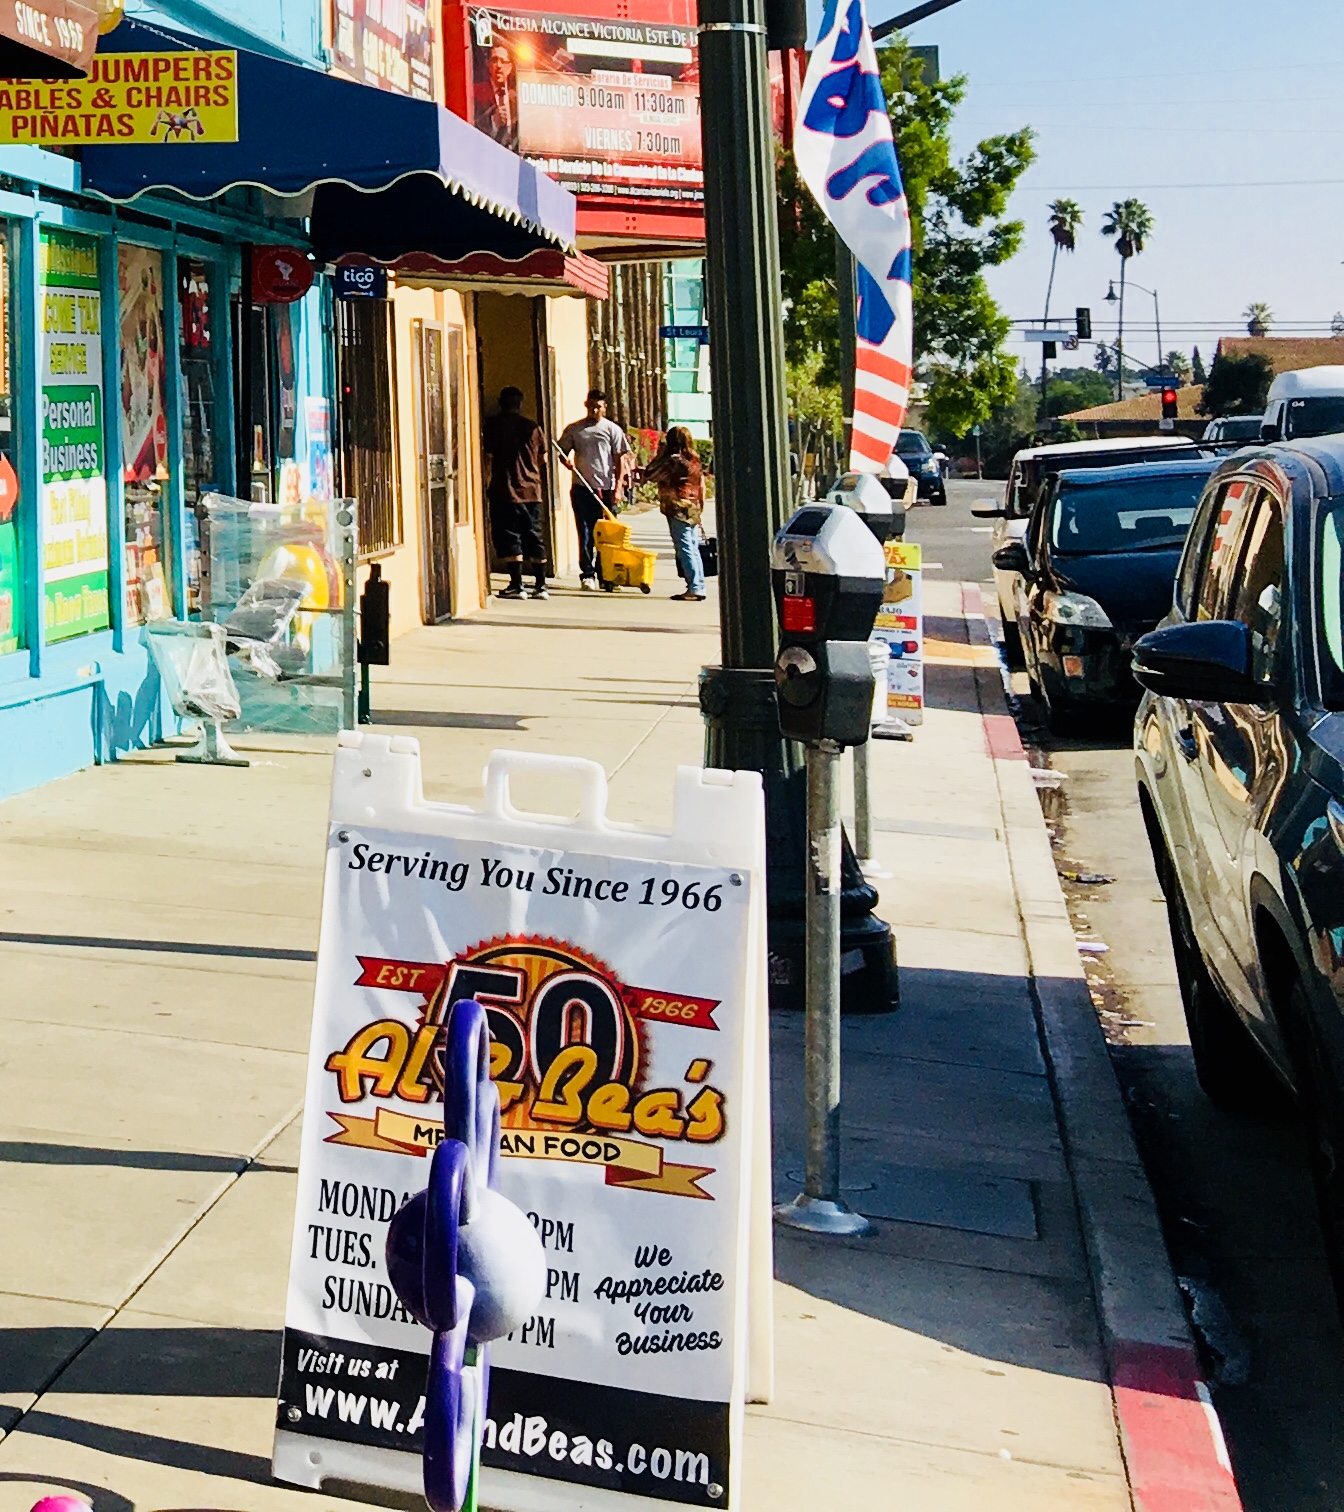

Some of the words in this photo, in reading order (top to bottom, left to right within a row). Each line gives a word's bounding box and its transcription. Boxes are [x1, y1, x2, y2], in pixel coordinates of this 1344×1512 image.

[13, 0, 54, 48] SINCE
[54, 15, 85, 53] 1966
[496, 13, 538, 33] IGLESIA
[540, 17, 590, 38] ALCANCE
[591, 21, 643, 43] VICTORIA
[645, 26, 669, 46] ESTE
[671, 29, 688, 48] DE
[88, 55, 234, 84] JUMPERS
[91, 87, 115, 109] &
[126, 84, 230, 108] CHAIRS
[521, 82, 575, 107] DOMINGO
[577, 86, 626, 110] 9:00am
[633, 91, 686, 115] 11:30am
[12, 110, 135, 138] PIÑATAS
[584, 127, 633, 152] VIERNES
[636, 131, 681, 155] 7:30pm
[42, 392, 97, 431] Personal
[42, 435, 99, 475] Business
[348, 843, 470, 892] Serving
[480, 858, 534, 893] You
[542, 868, 629, 904] Since
[638, 876, 724, 914] 1966
[375, 964, 426, 989] EST
[640, 995, 700, 1020] 1966
[531, 1044, 726, 1142] Bea's
[543, 1128, 622, 1162] FOOD
[308, 1223, 377, 1269] TUES.
[633, 1244, 673, 1268] We
[594, 1269, 725, 1303] Appreciate
[633, 1302, 694, 1325] Your
[615, 1328, 724, 1356] Business
[297, 1347, 345, 1375] Visit
[347, 1357, 373, 1378] us
[373, 1358, 400, 1381] at
